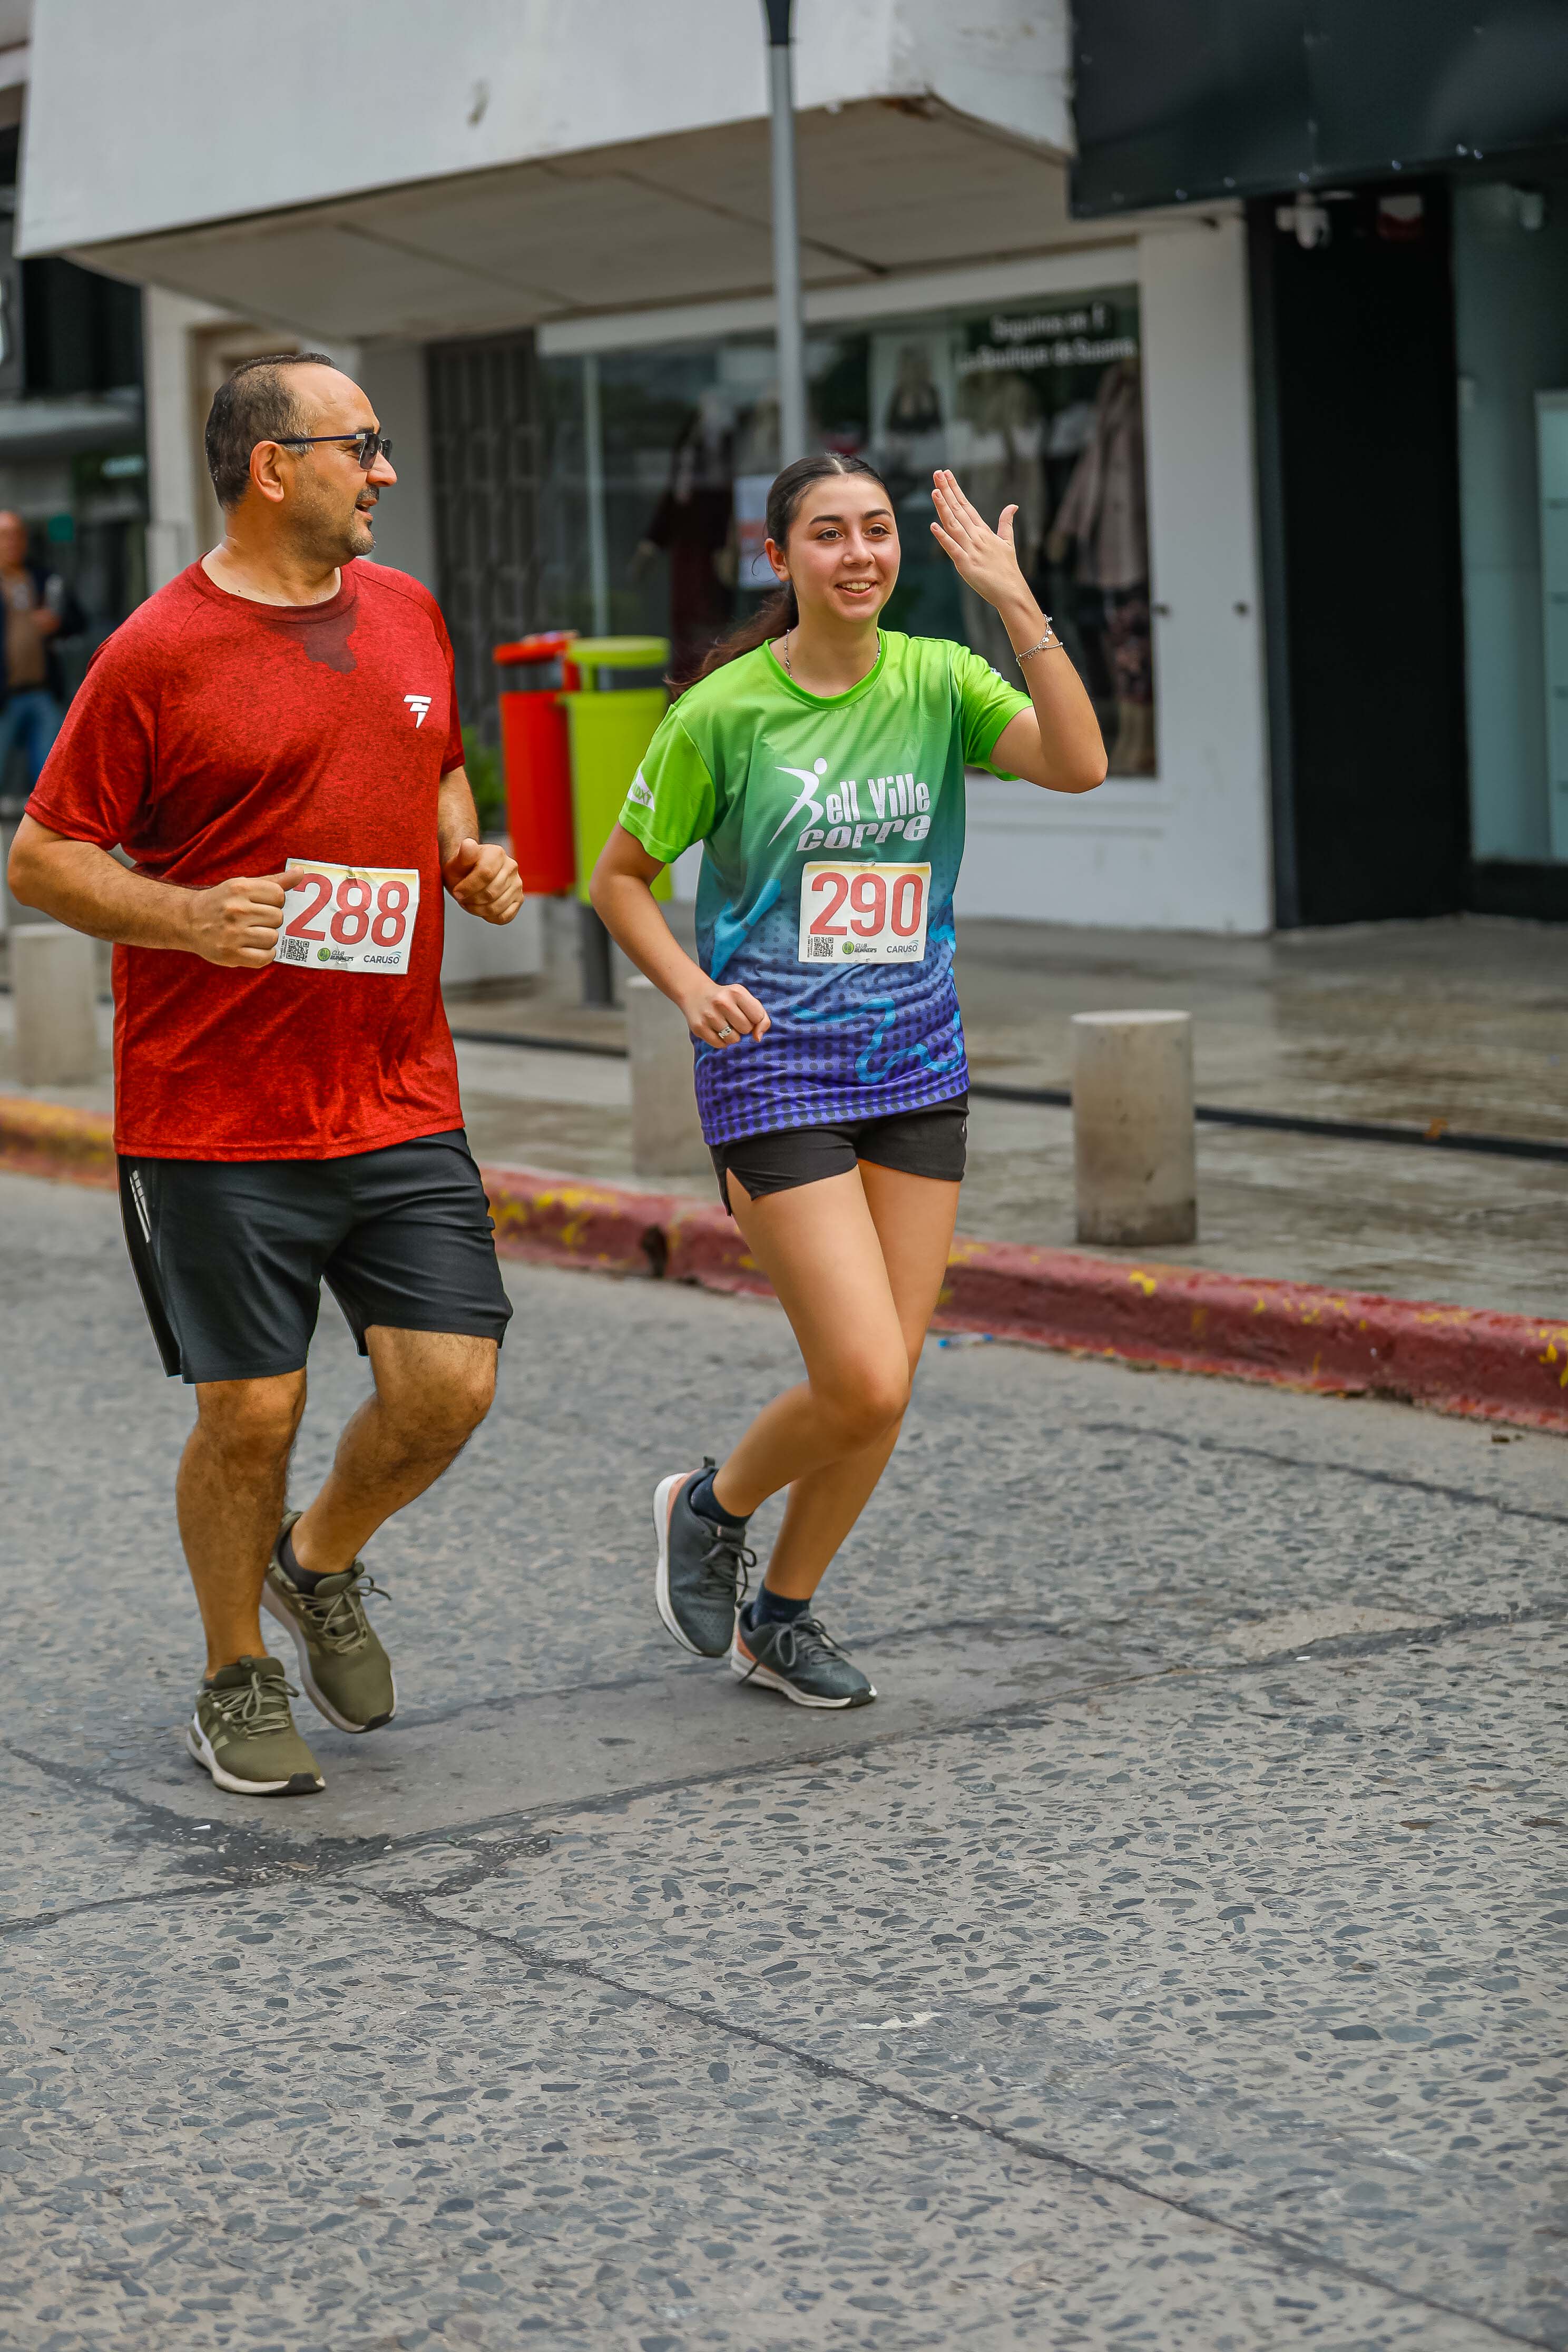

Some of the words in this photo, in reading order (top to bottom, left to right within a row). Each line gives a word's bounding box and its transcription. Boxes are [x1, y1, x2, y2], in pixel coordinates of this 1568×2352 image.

[867, 773, 930, 819] Ville
[796, 815, 930, 851] corre
[285, 873, 409, 947] 288
[810, 871, 923, 937] 290
[364, 955, 400, 964] CARUSO
[886, 945, 917, 953] CARUSO
